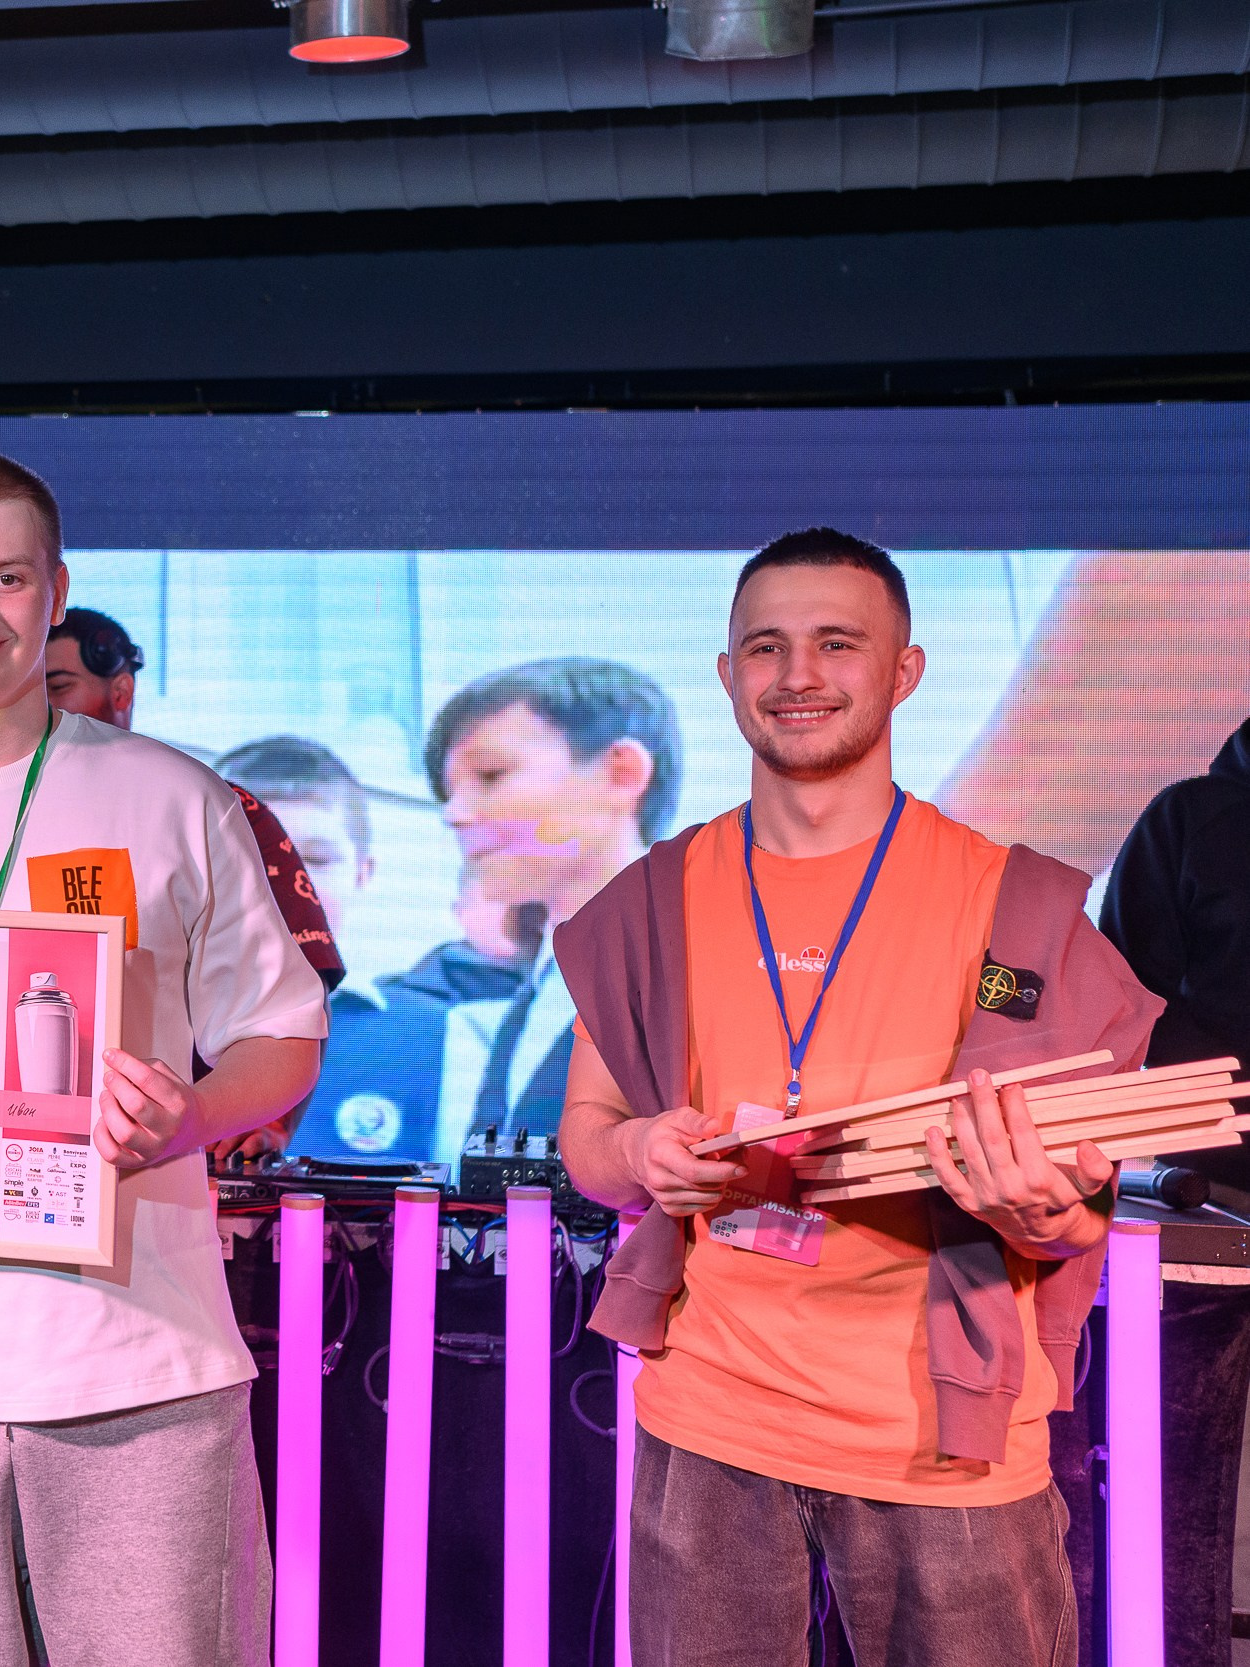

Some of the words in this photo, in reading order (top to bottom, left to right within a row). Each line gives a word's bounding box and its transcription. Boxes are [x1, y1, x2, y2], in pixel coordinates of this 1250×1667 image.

[61, 865, 103, 902] BEE
[757, 951, 840, 973] eless
[4, 1179, 24, 1187] simple
[722, 1188, 824, 1223] ОРГАНИЗАТОР
